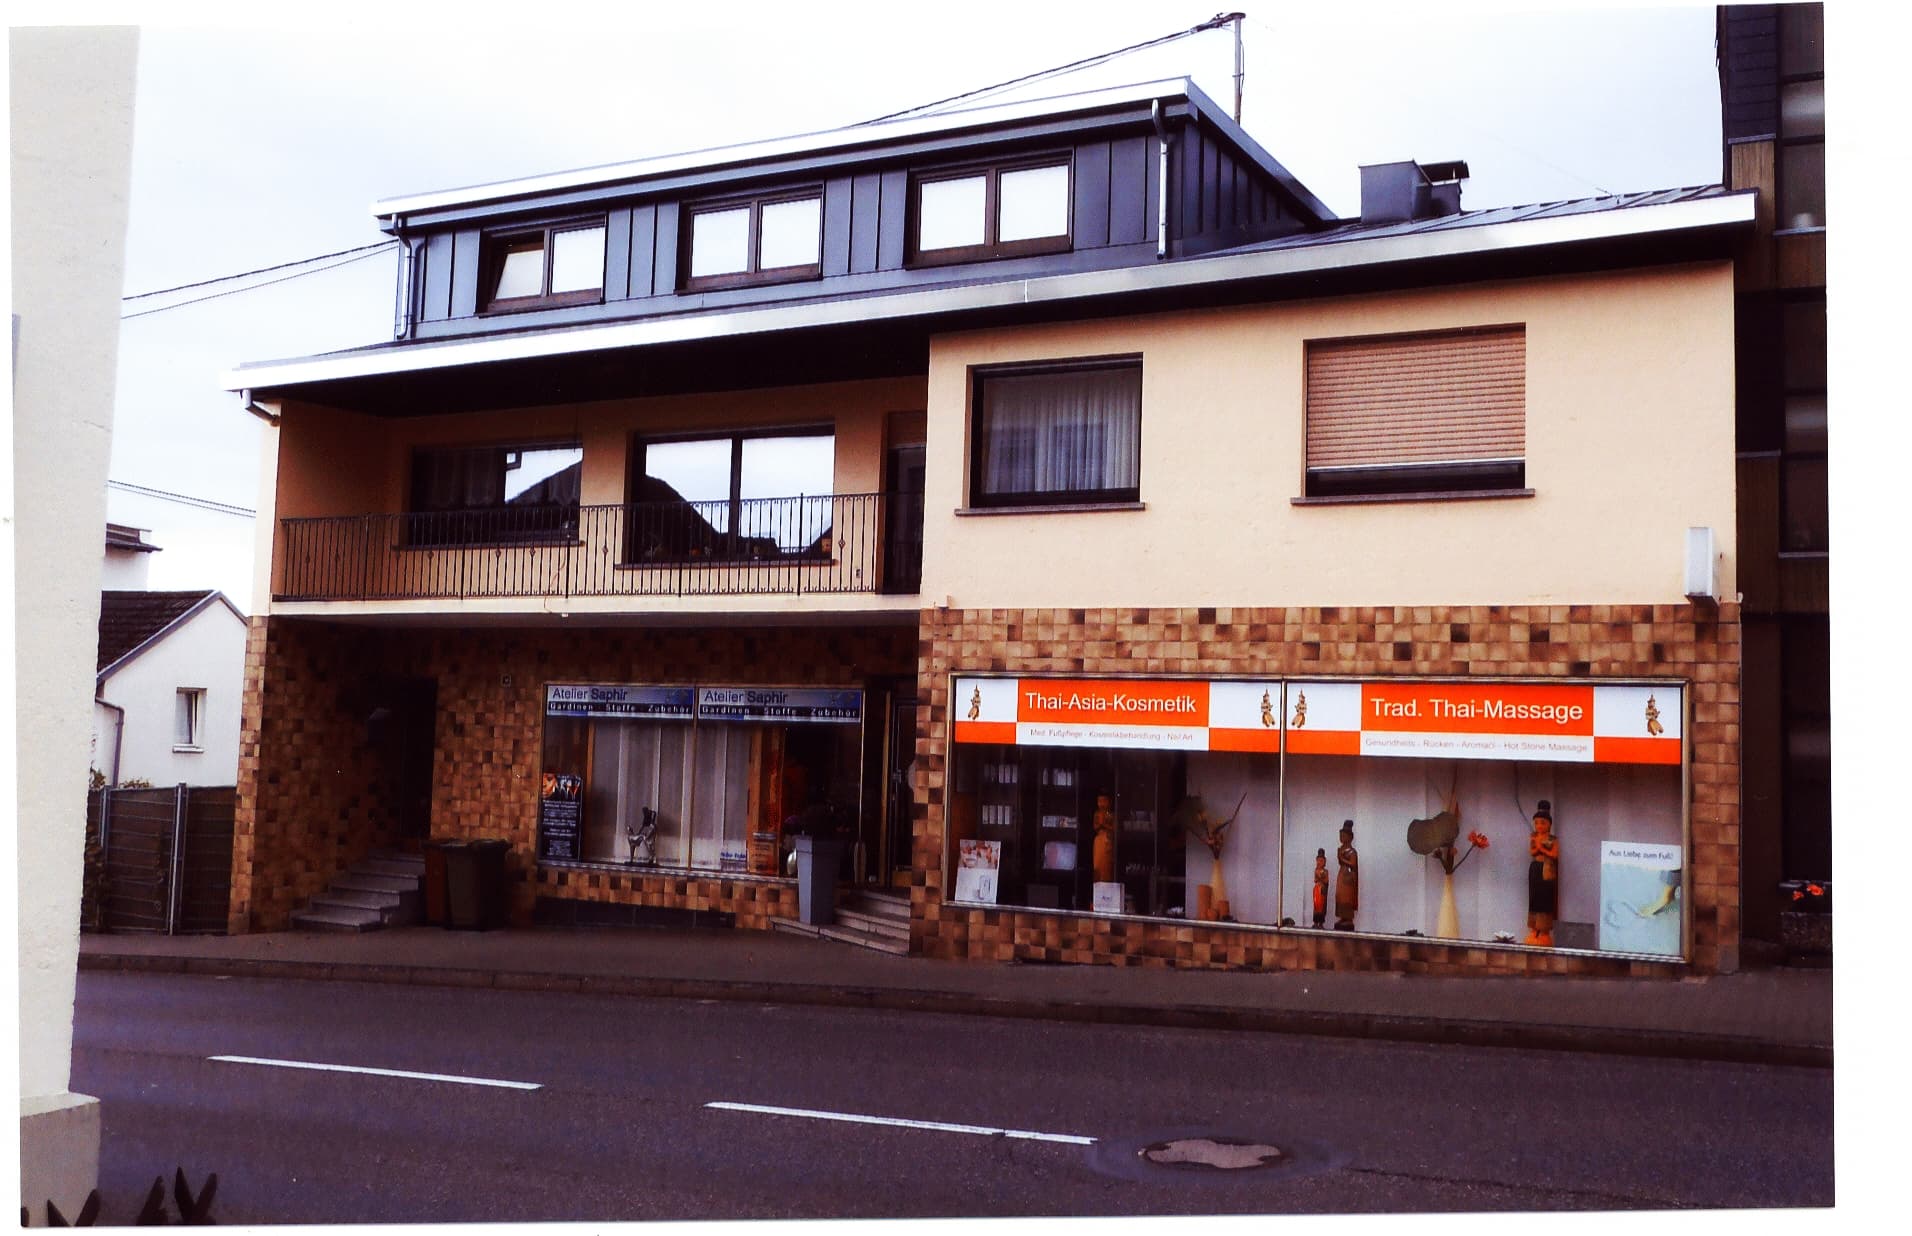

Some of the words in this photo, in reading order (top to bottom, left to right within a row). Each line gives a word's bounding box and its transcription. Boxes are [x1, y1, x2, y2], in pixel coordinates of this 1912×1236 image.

[552, 687, 588, 700] Atelier
[590, 687, 628, 703] Saphir
[704, 690, 744, 704] Atelier
[746, 691, 788, 706] Saphir
[1025, 692, 1197, 713] Thai-Asia-Kosmetik
[550, 703, 594, 711] Gardinen
[605, 704, 636, 712] Stoffe
[702, 706, 750, 715] Gardinen
[763, 707, 797, 716] Stoffe
[1370, 698, 1423, 717] Trad.
[1429, 699, 1584, 724] Thai-Massage
[1504, 742, 1519, 752] Hot
[1521, 742, 1546, 752] Stone
[1548, 743, 1588, 753] Massage
